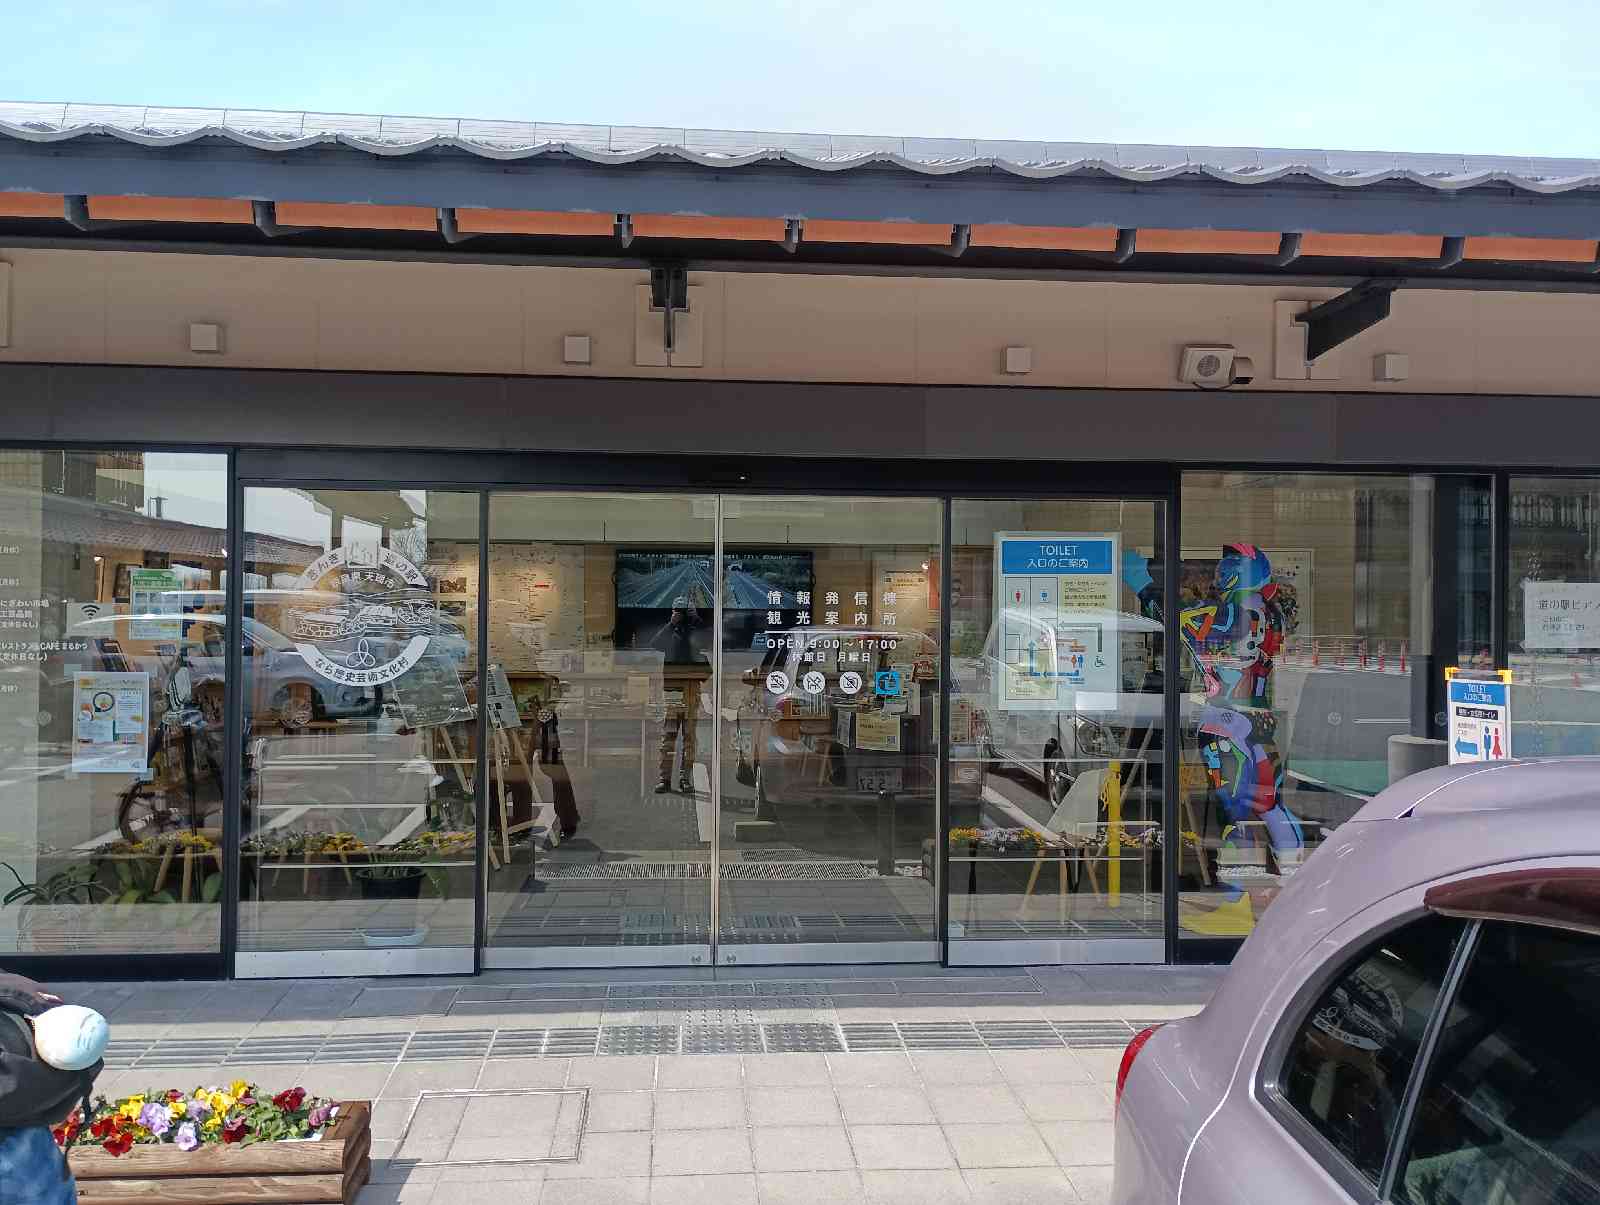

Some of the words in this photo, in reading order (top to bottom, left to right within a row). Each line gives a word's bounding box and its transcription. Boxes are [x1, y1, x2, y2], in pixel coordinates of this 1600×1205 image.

[1039, 545, 1080, 556] TOILET
[1026, 558, 1089, 569] 入口のご案内
[767, 590, 897, 606] 情報発信棟
[767, 611, 897, 626] 観光案内所
[766, 638, 804, 650] OPEN
